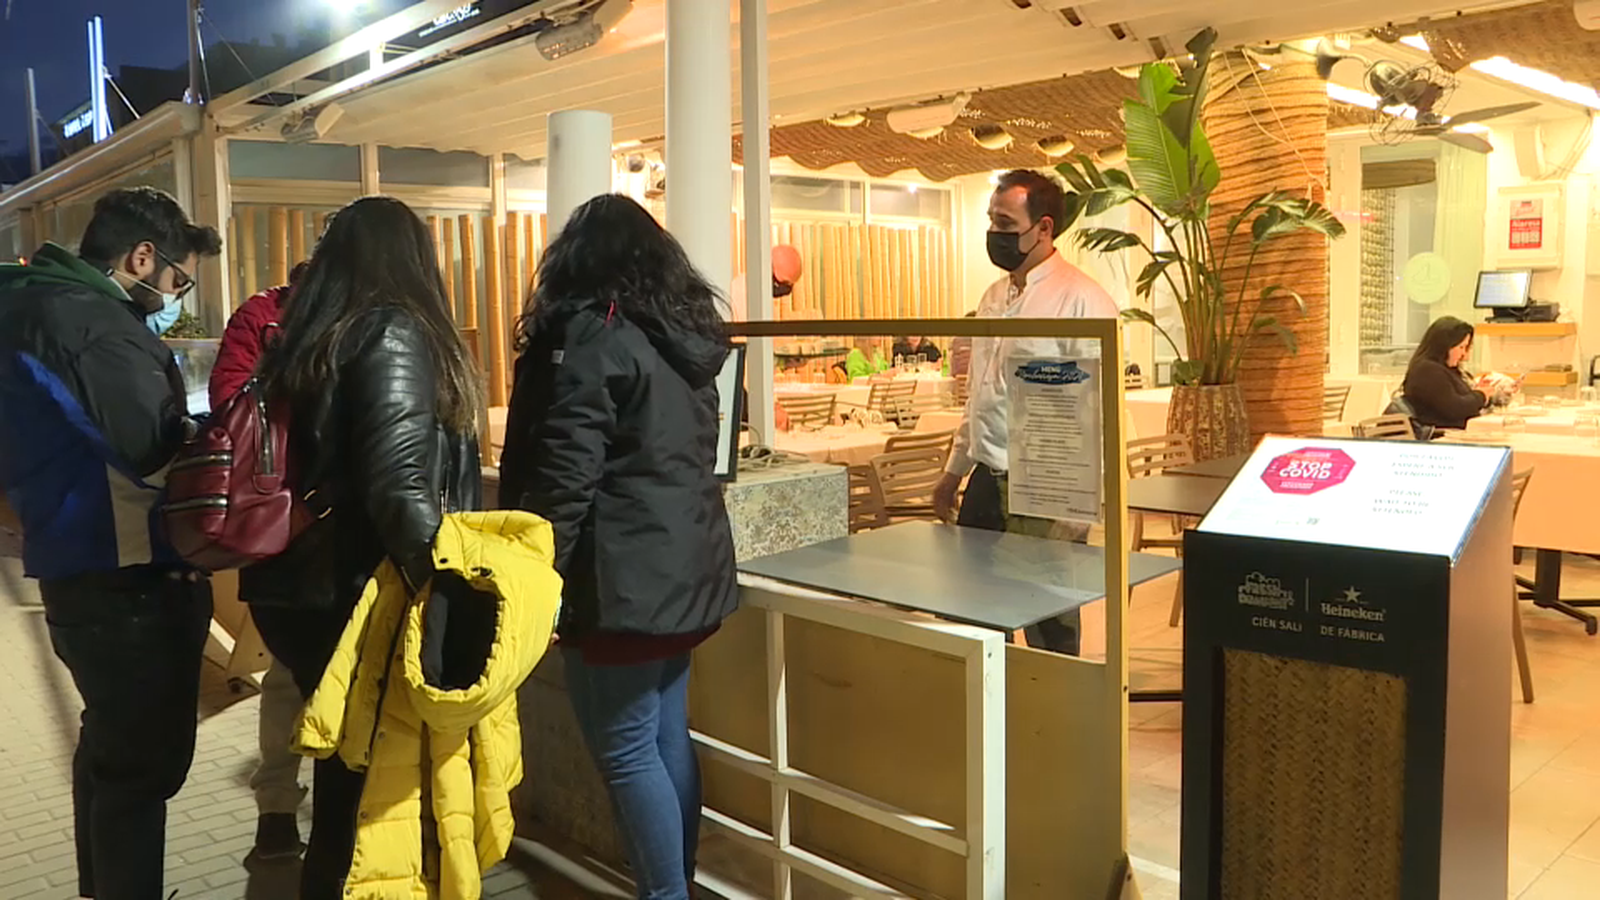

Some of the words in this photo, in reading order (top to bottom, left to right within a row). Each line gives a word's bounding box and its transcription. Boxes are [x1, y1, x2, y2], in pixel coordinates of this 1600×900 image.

[1287, 459, 1333, 471] STOP
[1279, 467, 1331, 480] COVID
[1320, 602, 1384, 621] Heineken
[1320, 625, 1335, 636] DE
